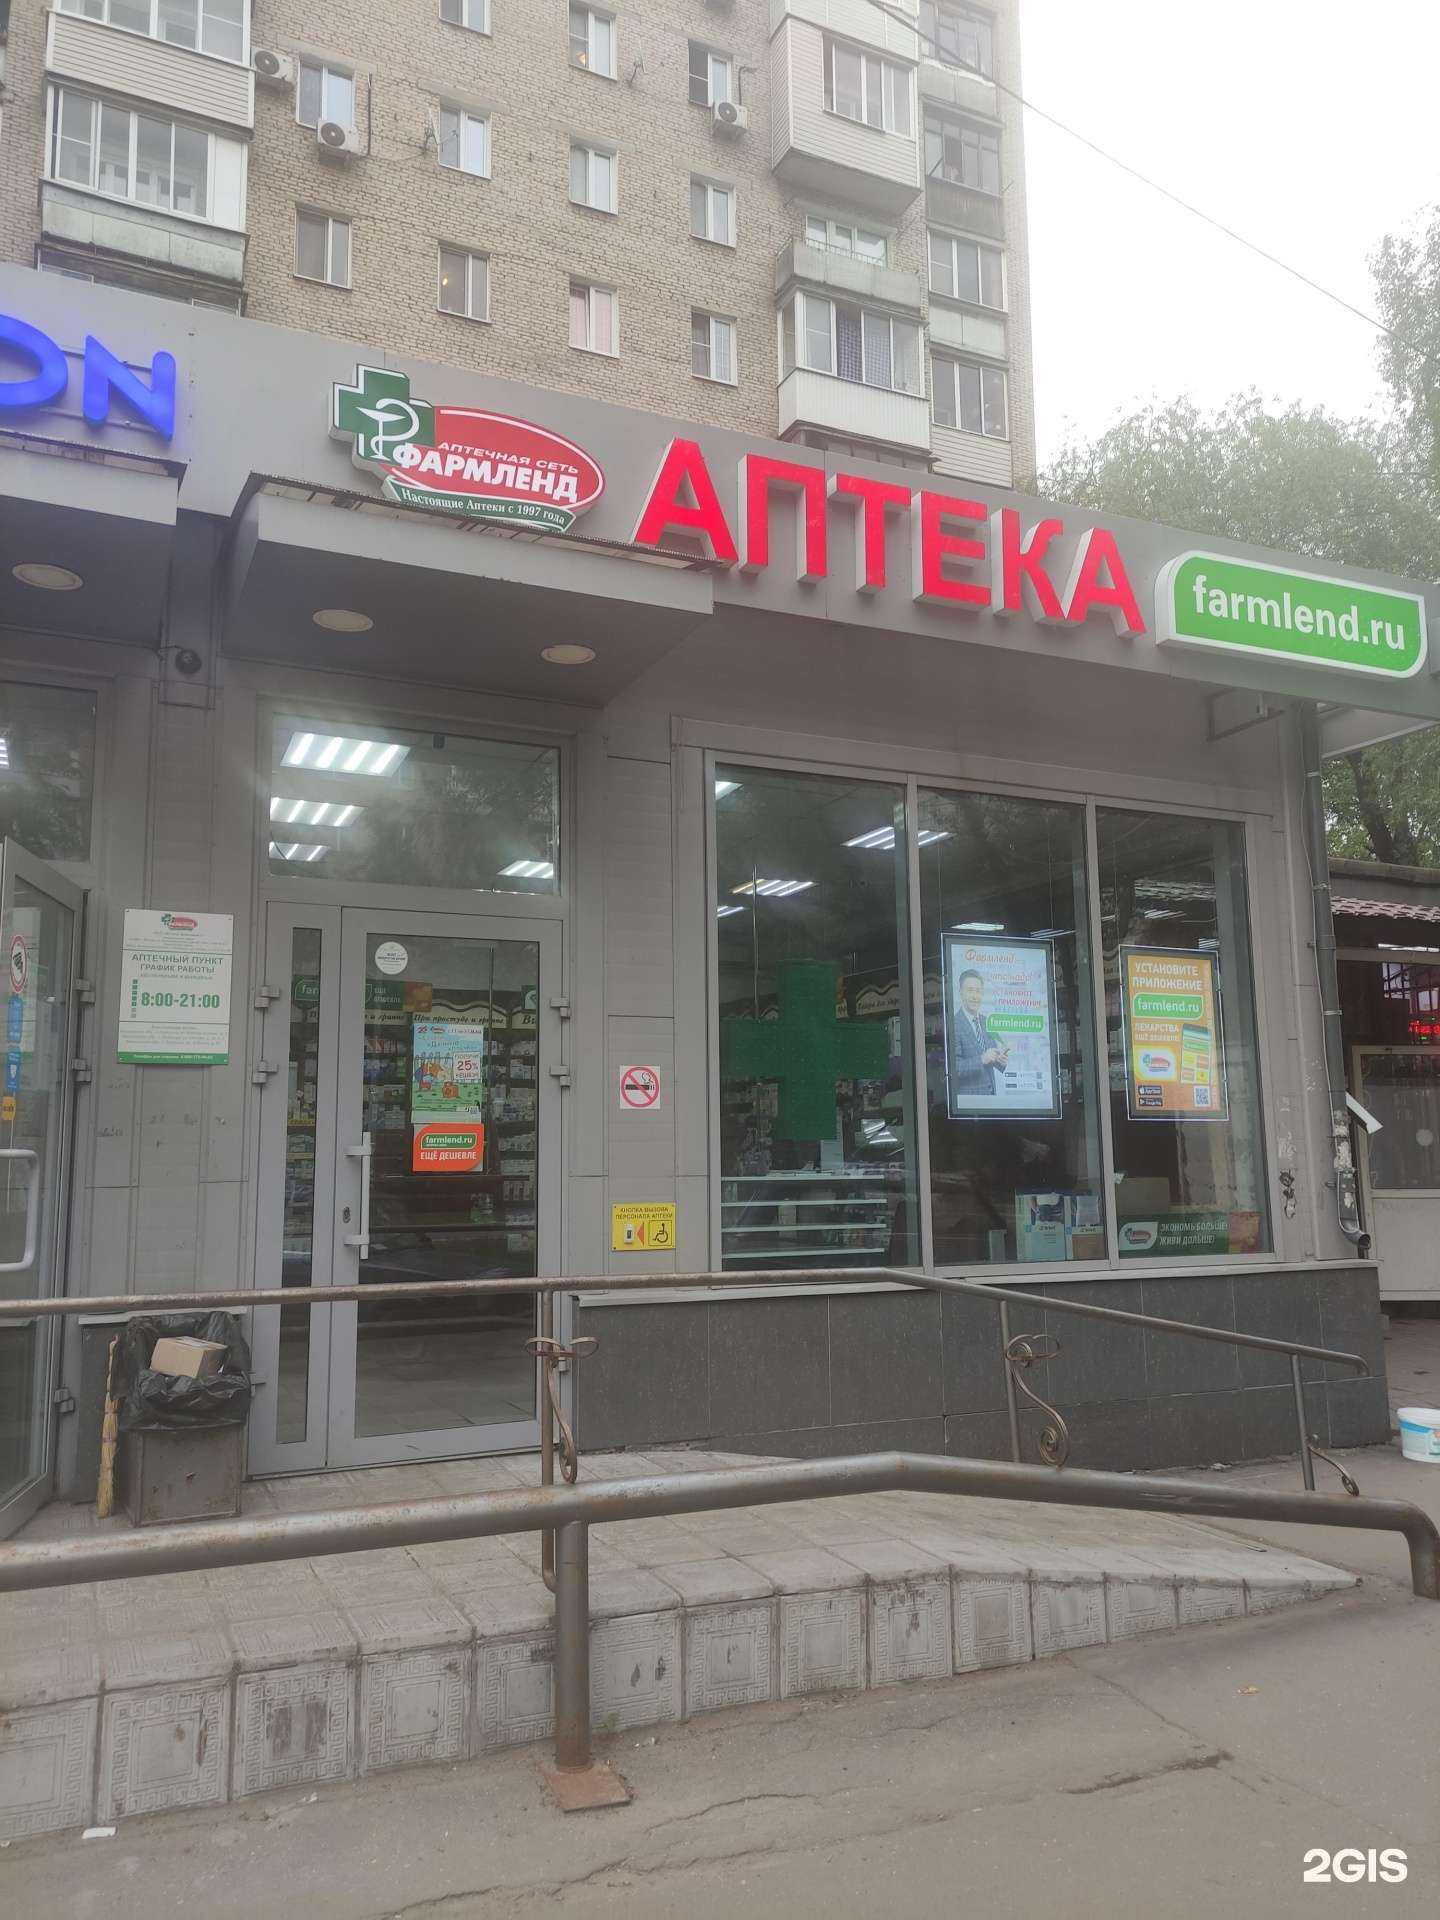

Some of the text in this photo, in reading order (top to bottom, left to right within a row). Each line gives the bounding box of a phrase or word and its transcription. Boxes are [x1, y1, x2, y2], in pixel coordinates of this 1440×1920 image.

[437, 441, 579, 474] АПТЕЧНАЯ СЕТЬ
[392, 443, 578, 503] ФАРМЛЕНД
[401, 488, 566, 526] Настоящие Аптеки с 1997 года
[632, 436, 1148, 638] АПТЕКА
[1192, 574, 1405, 650] farmlend.ru
[131, 953, 224, 965] АПТЕЧНЫЙ ПУНКТ
[140, 963, 215, 974] ГРАФИК РАБОТЫ
[1135, 962, 1199, 976] УСТАНОВИТЕ
[1133, 976, 1203, 991] ПРИЛОЖЕНИЕ
[141, 992, 221, 1009] 8:00-21:00
[1138, 998, 1200, 1013] farmlend.ru
[990, 1017, 1042, 1029] farmlend.ru
[425, 1134, 473, 1145] farmlend.ru
[420, 1150, 477, 1161] ЕЩЁ ДЕШЕВЛЕ
[1160, 1222, 1195, 1233] ЭКОНОМЬ
[1159, 1236, 1181, 1247] ЖИВИ
